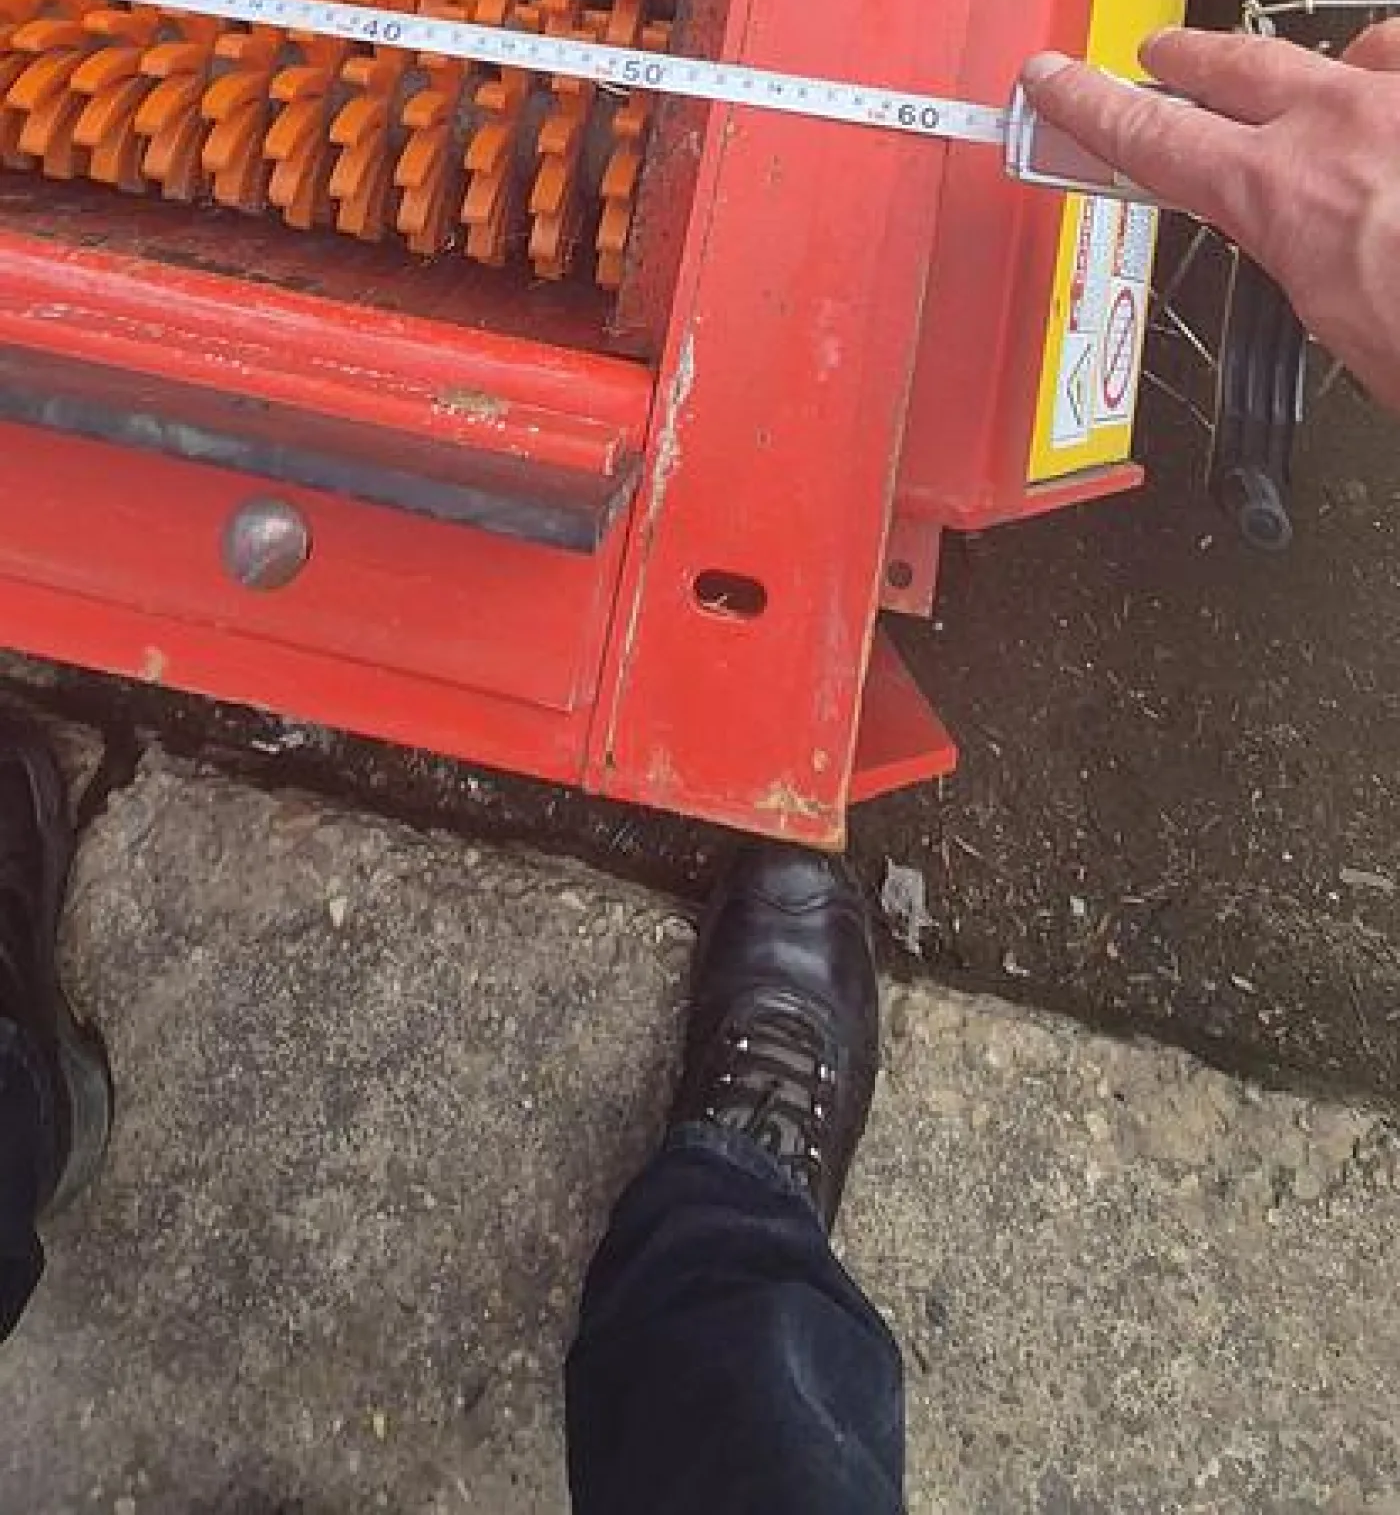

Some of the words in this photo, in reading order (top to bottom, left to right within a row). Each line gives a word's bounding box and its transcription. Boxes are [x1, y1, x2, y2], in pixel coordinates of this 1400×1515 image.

[362, 19, 401, 42] 40
[622, 59, 664, 85] 50
[898, 103, 940, 129] 60
